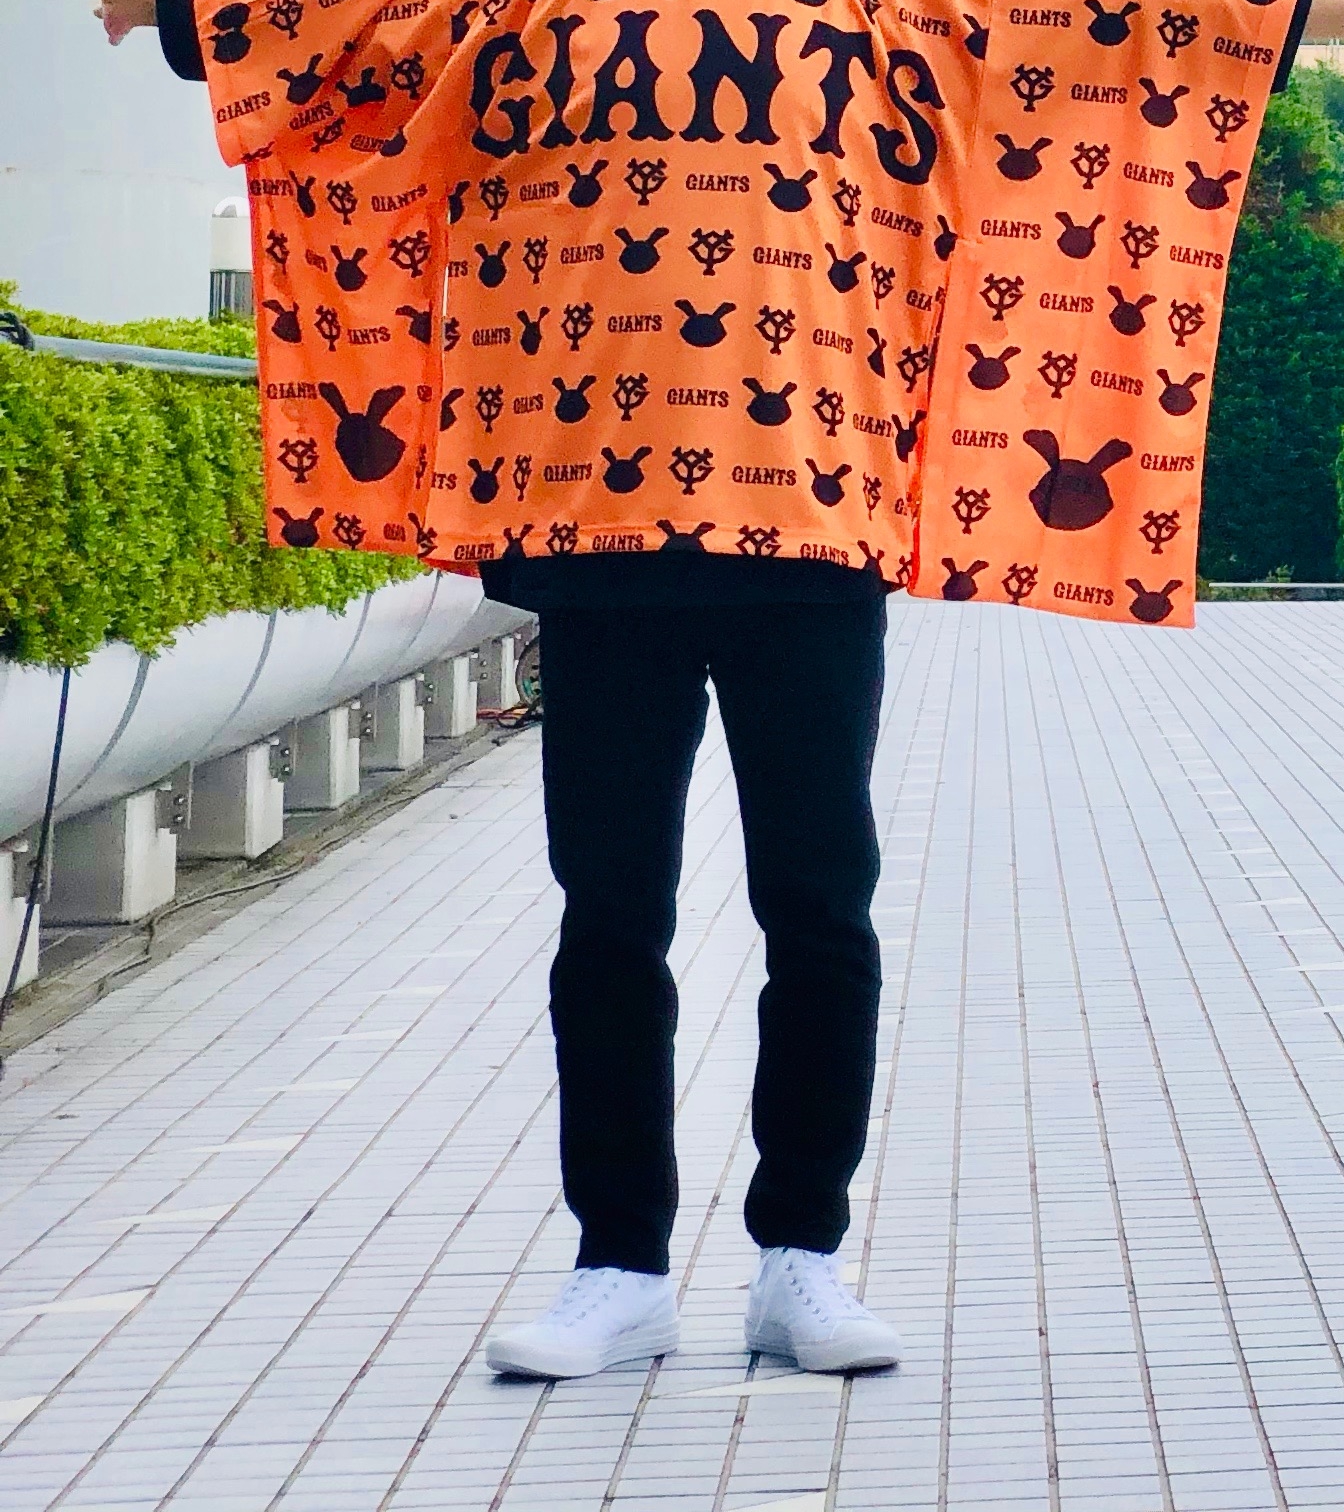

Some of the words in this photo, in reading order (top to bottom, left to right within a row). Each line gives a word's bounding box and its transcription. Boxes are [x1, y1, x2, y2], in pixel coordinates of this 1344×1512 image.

[899, 8, 951, 37] GIANTS
[1010, 8, 1071, 28] GIANTS
[1214, 37, 1273, 65] GIANTS
[469, 9, 944, 185] GIANTS
[1071, 84, 1128, 104] GIANTS
[217, 91, 270, 123] GIANTS
[686, 174, 749, 192] GIANTS
[1124, 162, 1174, 187] GIANTS
[520, 181, 559, 201] GIANTS
[871, 207, 923, 237] GIANTS
[981, 220, 1041, 240] GIANTS
[561, 244, 604, 264] GIANTS
[753, 247, 812, 270] GIANTS
[1170, 244, 1224, 269] GIANTS
[1040, 293, 1093, 312] GIANTS
[608, 315, 662, 333] GIANTS
[473, 327, 511, 346] GIANTS
[1091, 370, 1143, 396] GIANTS
[667, 388, 729, 407] GIANTS
[952, 429, 1007, 448] GIANTS
[1141, 453, 1194, 471] GIANTS
[543, 463, 592, 482] GIANTS
[732, 466, 796, 486] GIANTS
[592, 533, 644, 551] GIANTS
[1054, 582, 1113, 606] GIANTS
